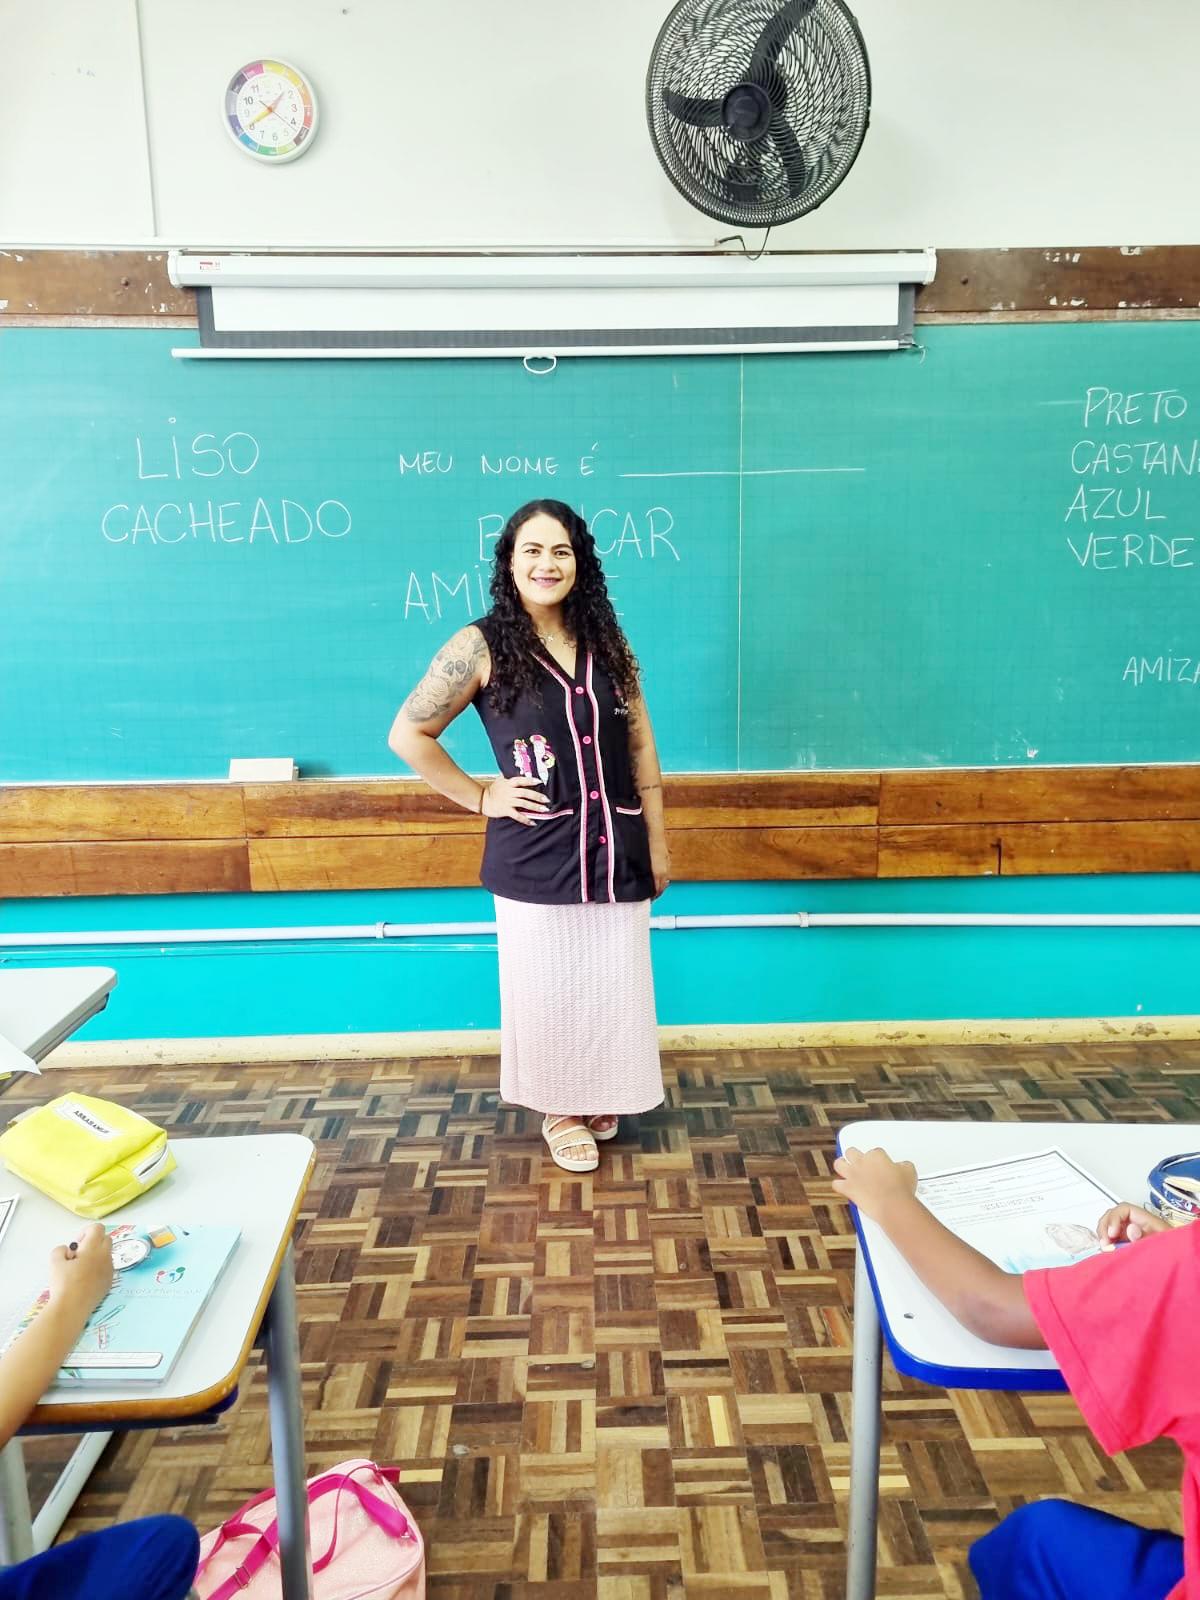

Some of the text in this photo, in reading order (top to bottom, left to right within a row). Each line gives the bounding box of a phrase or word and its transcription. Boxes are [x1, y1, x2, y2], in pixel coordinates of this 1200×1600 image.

[243, 96, 254, 105] 10
[251, 84, 259, 94] 11
[288, 90, 293, 99] 2
[290, 117, 296, 126] 4
[291, 104, 298, 113] 3
[1084, 386, 1188, 428] PRETO
[136, 417, 260, 480] LISO
[399, 442, 599, 476] MEU NOME É
[1071, 439, 1200, 476] CASTAN
[1064, 483, 1168, 523] AZUL
[102, 497, 352, 545] CACHEADO
[1066, 532, 1195, 570] VERDE
